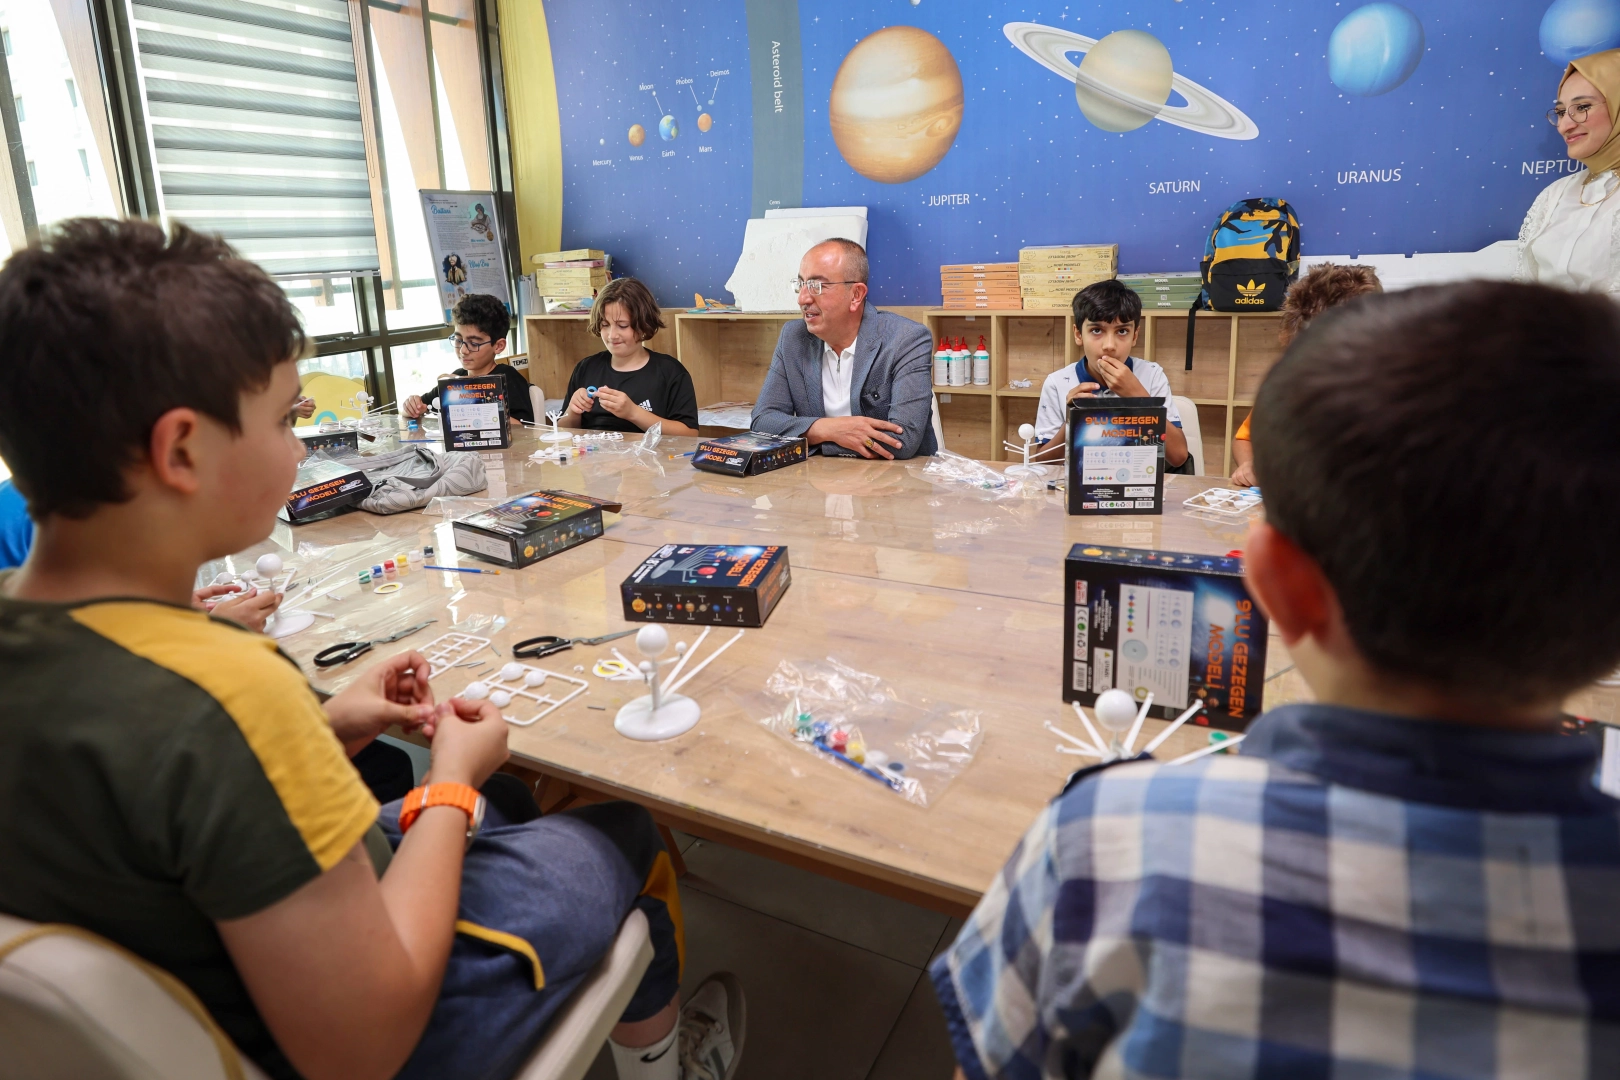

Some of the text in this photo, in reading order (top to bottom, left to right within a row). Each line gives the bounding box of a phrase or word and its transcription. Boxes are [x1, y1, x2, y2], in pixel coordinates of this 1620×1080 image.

[710, 69, 730, 77] Deimos
[772, 41, 784, 113] Asteroid belt
[1521, 159, 1586, 175] NEPTU
[1337, 168, 1402, 184] URANUS
[1149, 180, 1201, 195] SATURN
[928, 193, 970, 207] JUPITER
[459, 391, 486, 399] MODELİ
[1085, 416, 1159, 425] 9'LU GEZEGEN
[1101, 427, 1142, 437] MODELİ
[704, 454, 726, 462] MODELİ
[712, 447, 738, 456] GEZEGEN
[308, 479, 346, 494] GEZEGEN
[305, 488, 337, 502] MODELİ
[726, 553, 752, 576] MODELİ
[737, 559, 769, 587] GEZEGEN
[1206, 623, 1225, 690] MODELİ
[1229, 599, 1252, 719] 9'LU GEZEGEN
